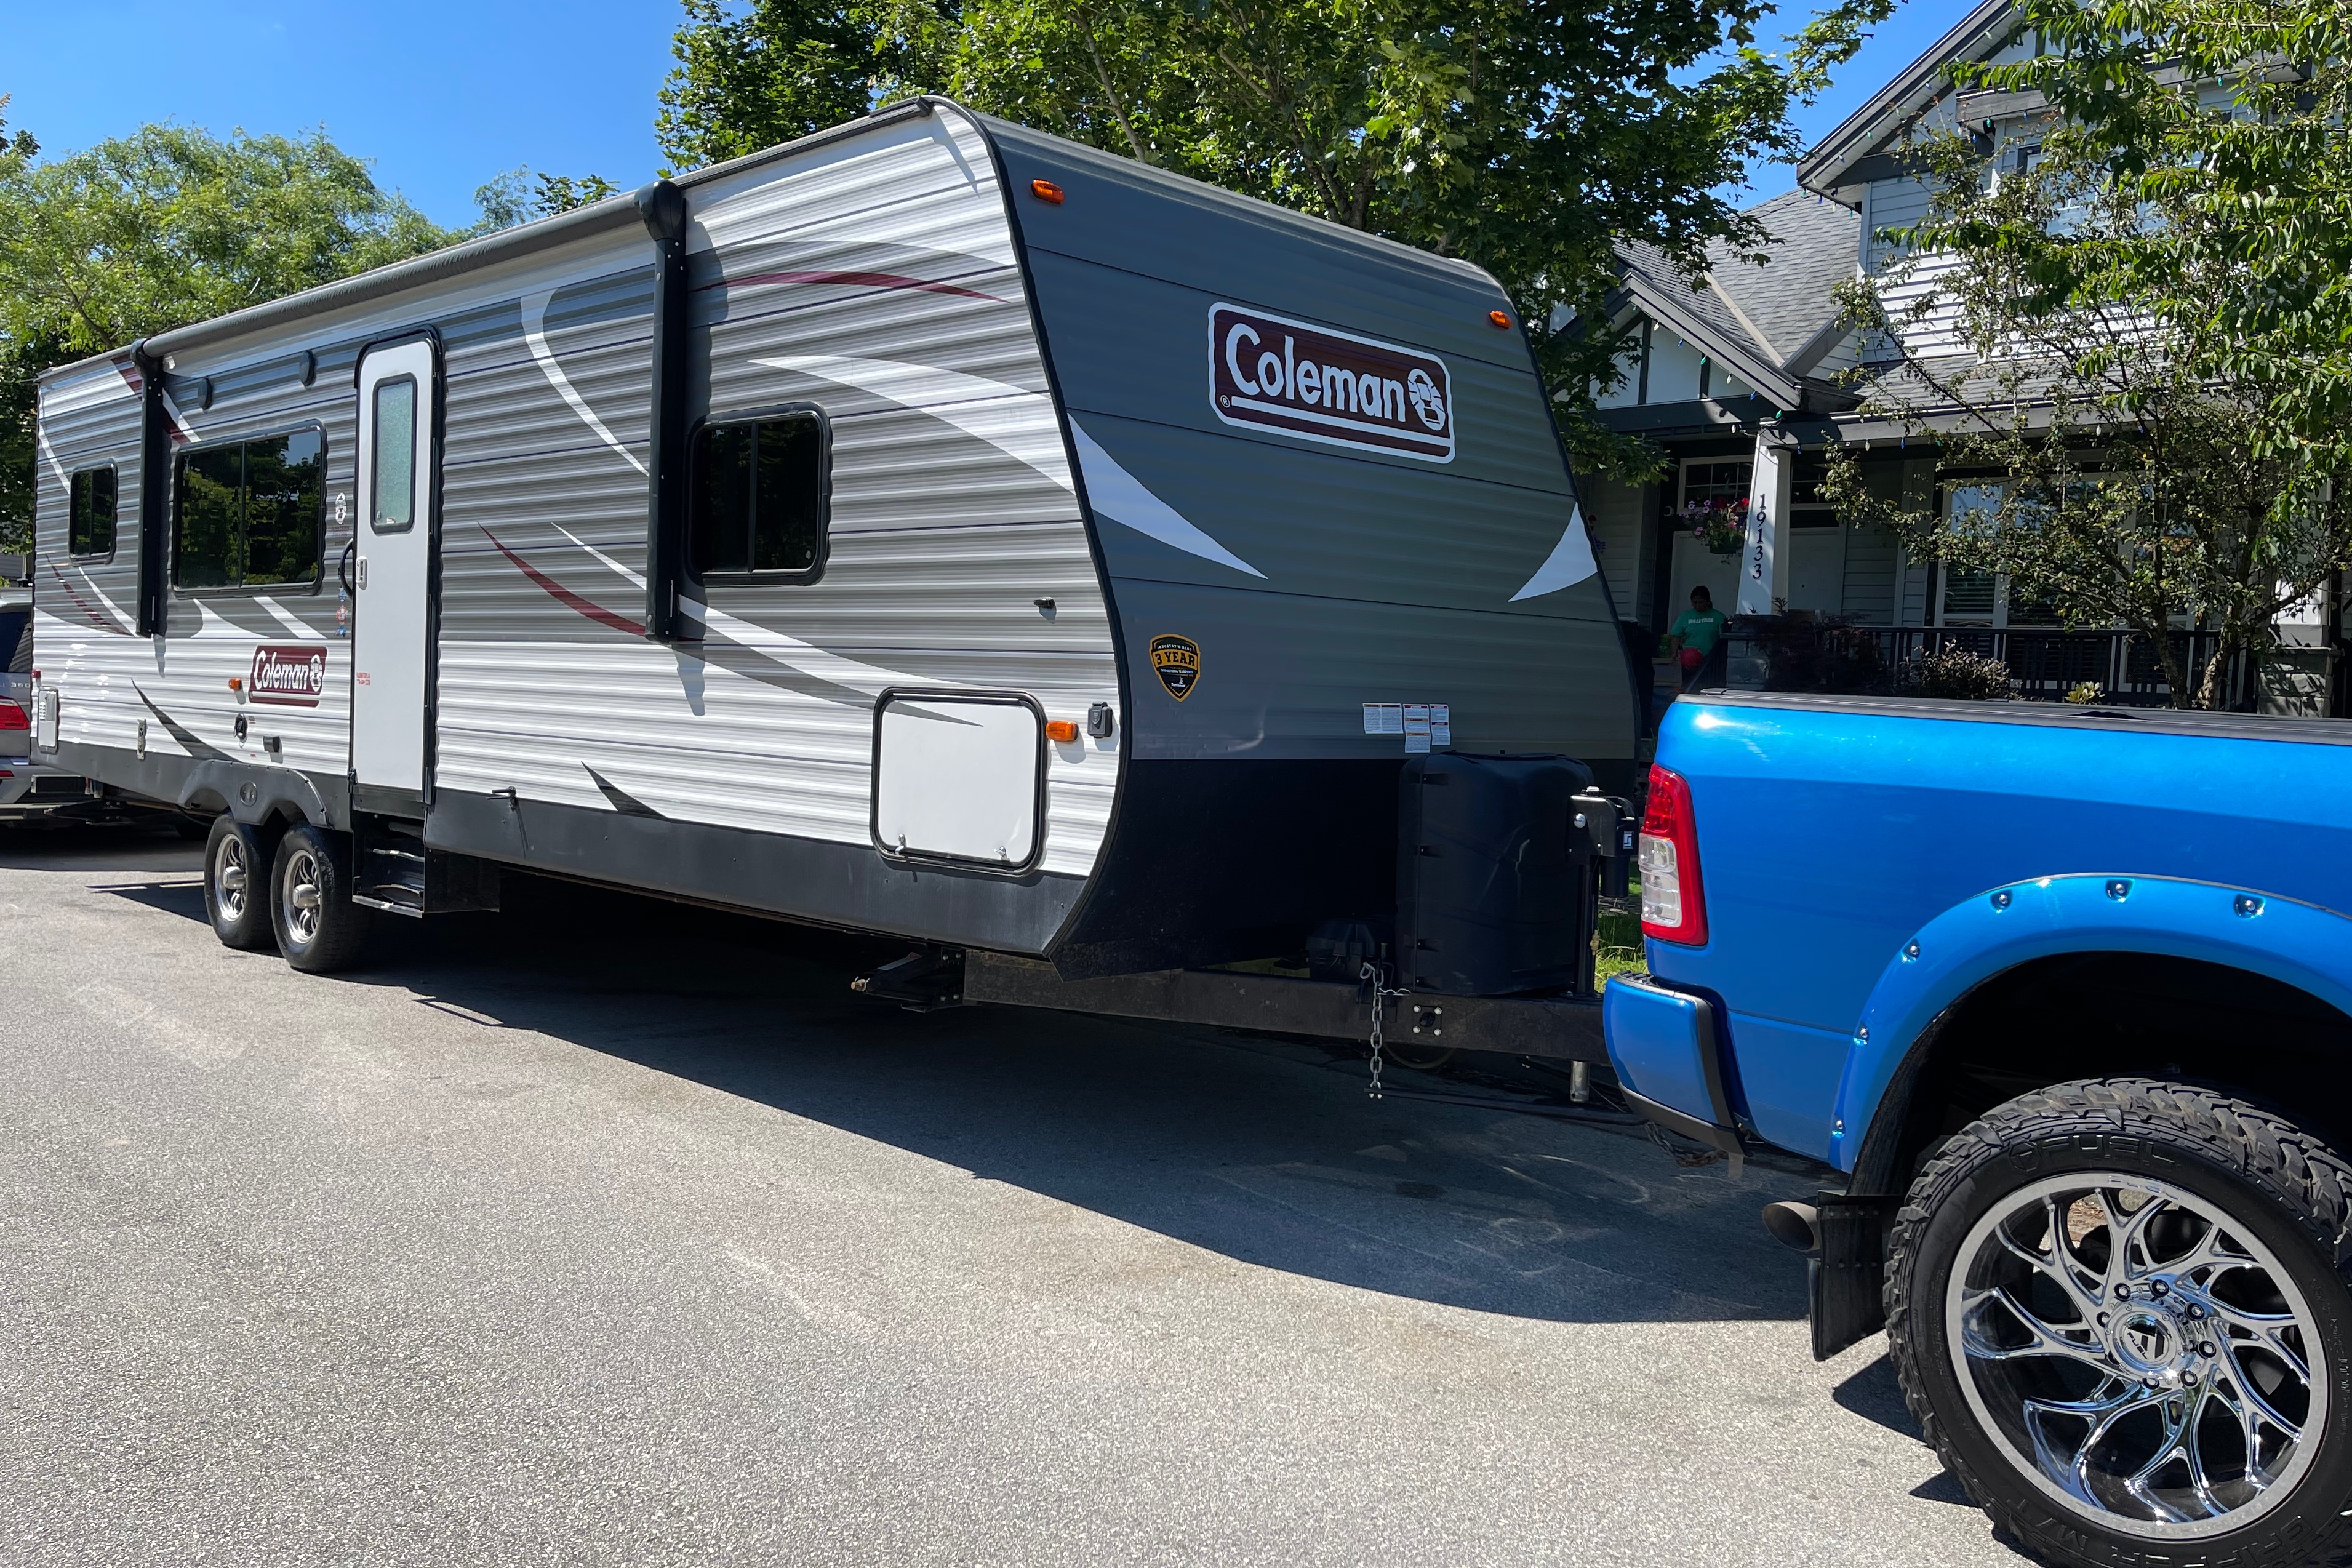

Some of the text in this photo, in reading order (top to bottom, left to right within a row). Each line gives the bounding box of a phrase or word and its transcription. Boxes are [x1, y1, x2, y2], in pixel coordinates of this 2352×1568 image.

[1226, 323, 1406, 423] Coleman
[1752, 493, 1766, 579] 19133
[254, 650, 309, 690] Coleman
[1155, 651, 1195, 666] 3 YEAR
[2041, 1134, 2179, 1166] FUEL
[2127, 1332, 2148, 1361] FUEL
